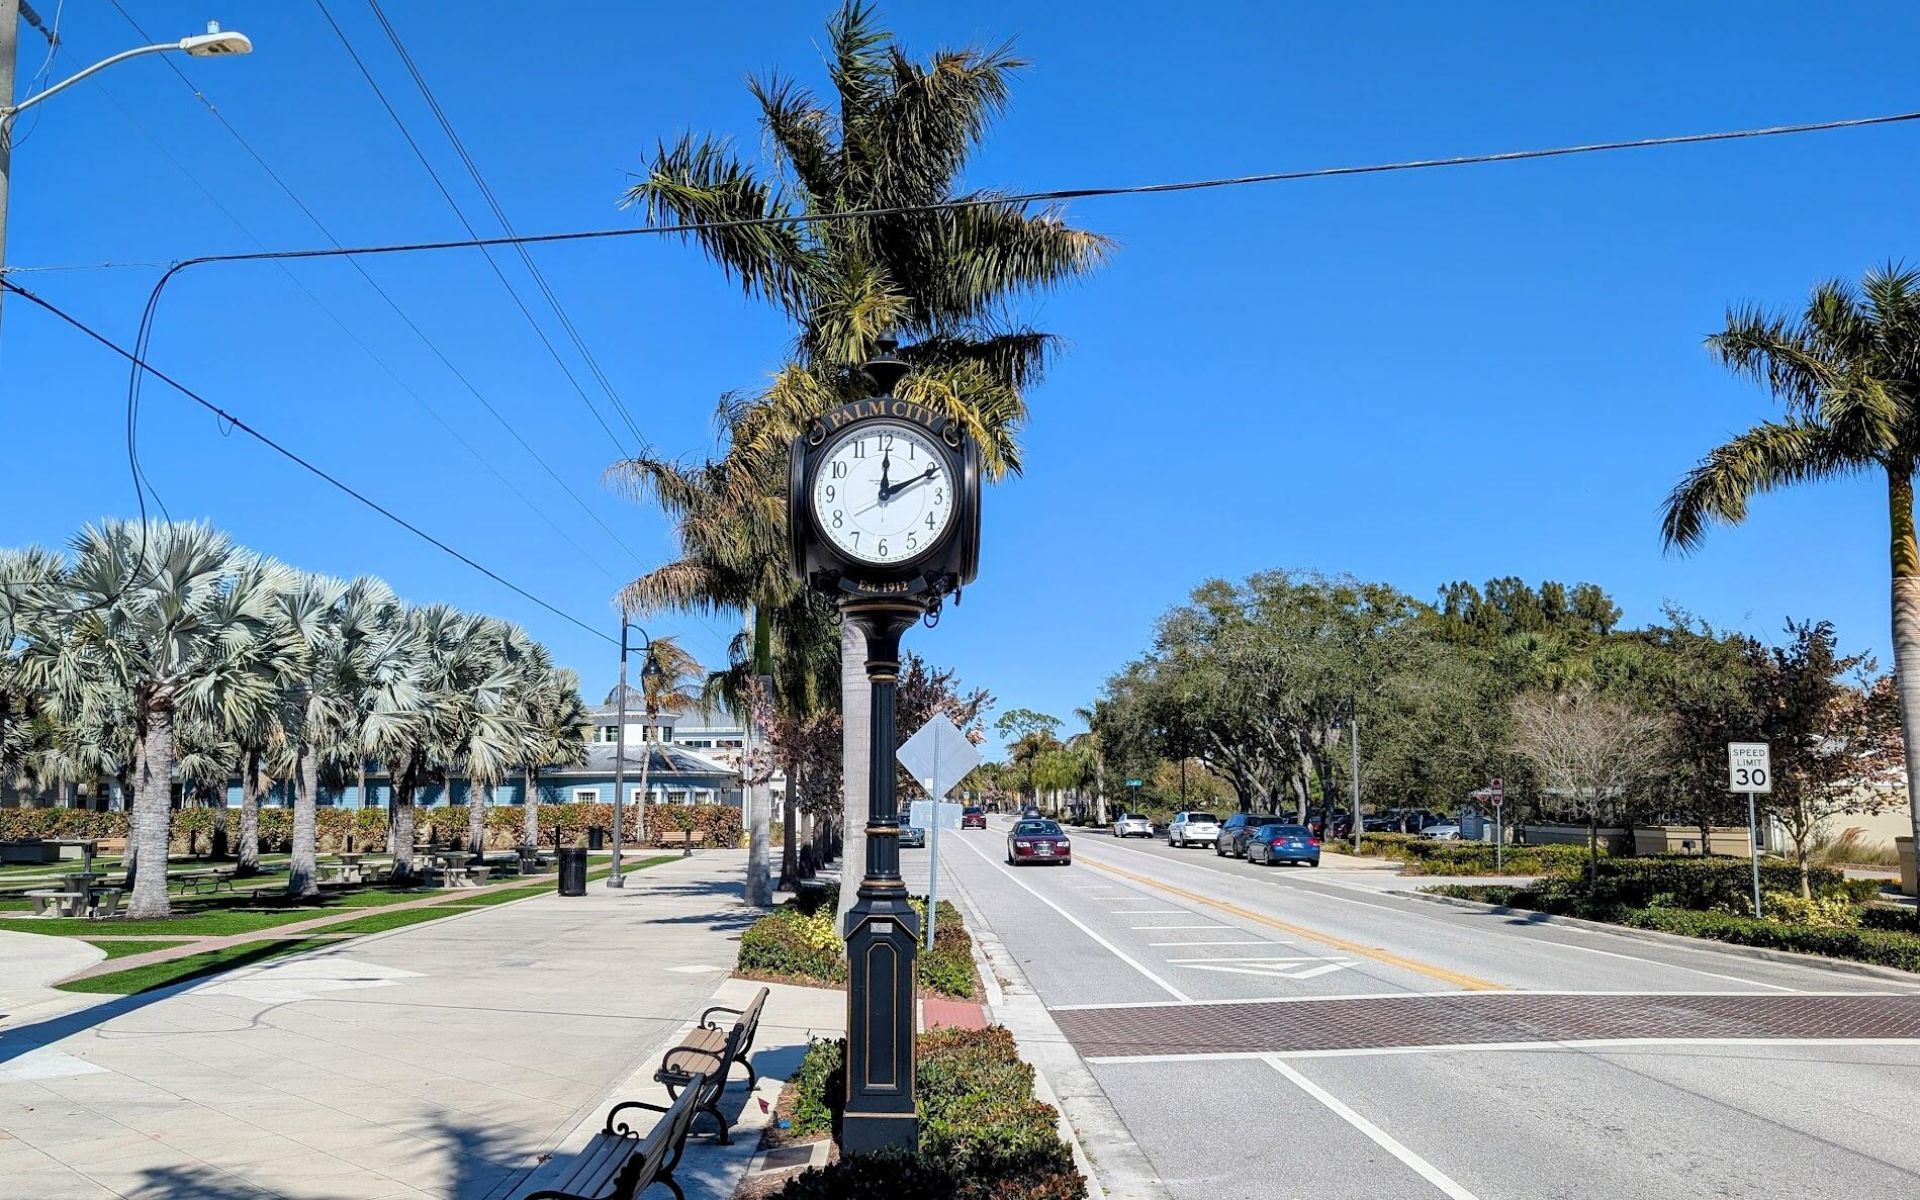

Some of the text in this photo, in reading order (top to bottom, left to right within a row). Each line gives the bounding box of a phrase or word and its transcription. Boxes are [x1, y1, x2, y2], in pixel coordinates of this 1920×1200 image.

[829, 400, 938, 429] PALM CITY
[852, 441, 866, 459] 11
[877, 434, 894, 452] 12
[908, 443, 916, 460] 1
[831, 461, 847, 479] 10
[926, 462, 937, 480] 2
[825, 485, 835, 503] 9
[934, 487, 943, 505] 3
[832, 510, 843, 528] 8
[925, 511, 936, 530] 4
[849, 532, 860, 549] 7
[878, 538, 888, 557] 6
[906, 531, 917, 550] 5
[882, 580, 909, 593] 1912
[1733, 748, 1766, 757] SPEED
[1737, 758, 1763, 767] LIMIT
[1736, 768, 1766, 786] 30
